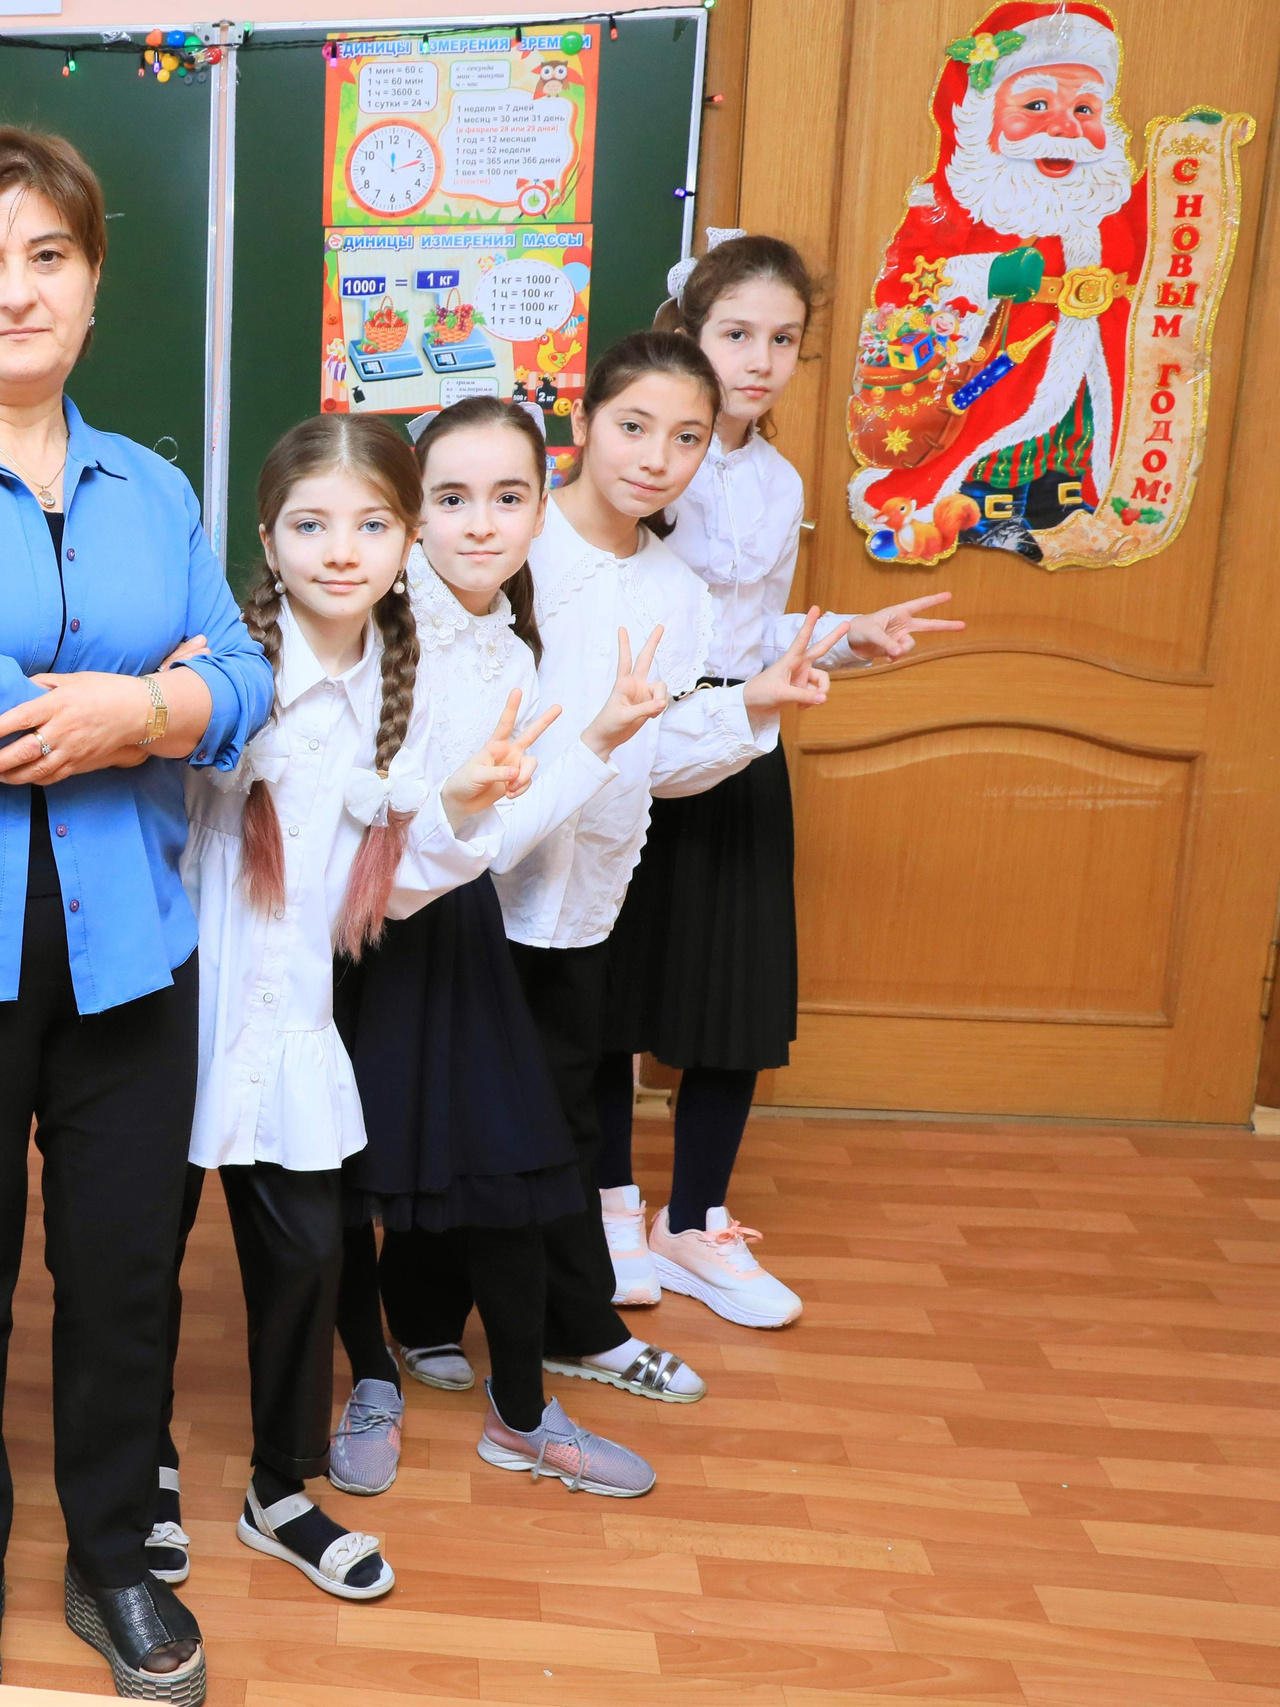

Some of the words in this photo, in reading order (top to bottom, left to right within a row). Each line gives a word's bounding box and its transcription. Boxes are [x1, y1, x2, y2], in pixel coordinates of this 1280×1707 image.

[520, 34, 592, 51] ВРЕМИ
[1172, 157, 1199, 185] С
[342, 234, 414, 250] ДИНИЦЫ
[421, 234, 516, 249] ИЗМЕРЕНИЯ
[522, 233, 584, 248] МАССЫ
[1152, 193, 1203, 338] НОВЫМ
[344, 279, 377, 295] 1000
[378, 282, 385, 293] г
[426, 273, 434, 286] 1
[439, 274, 453, 288] кг
[492, 276, 498, 284] 1
[502, 276, 514, 287] кг
[526, 274, 551, 284] 1000
[553, 276, 560, 284] г
[492, 289, 497, 298] 1
[501, 291, 508, 300] ц
[522, 288, 541, 298] 100
[543, 290, 554, 300] кг
[491, 302, 496, 311] 1
[520, 302, 545, 312] 1000
[548, 303, 560, 313] кг
[491, 316, 496, 324] 1
[519, 316, 531, 325] 10
[534, 318, 542, 326] ц
[538, 392, 546, 402] 2
[1130, 363, 1181, 505] ГОДОМ!
